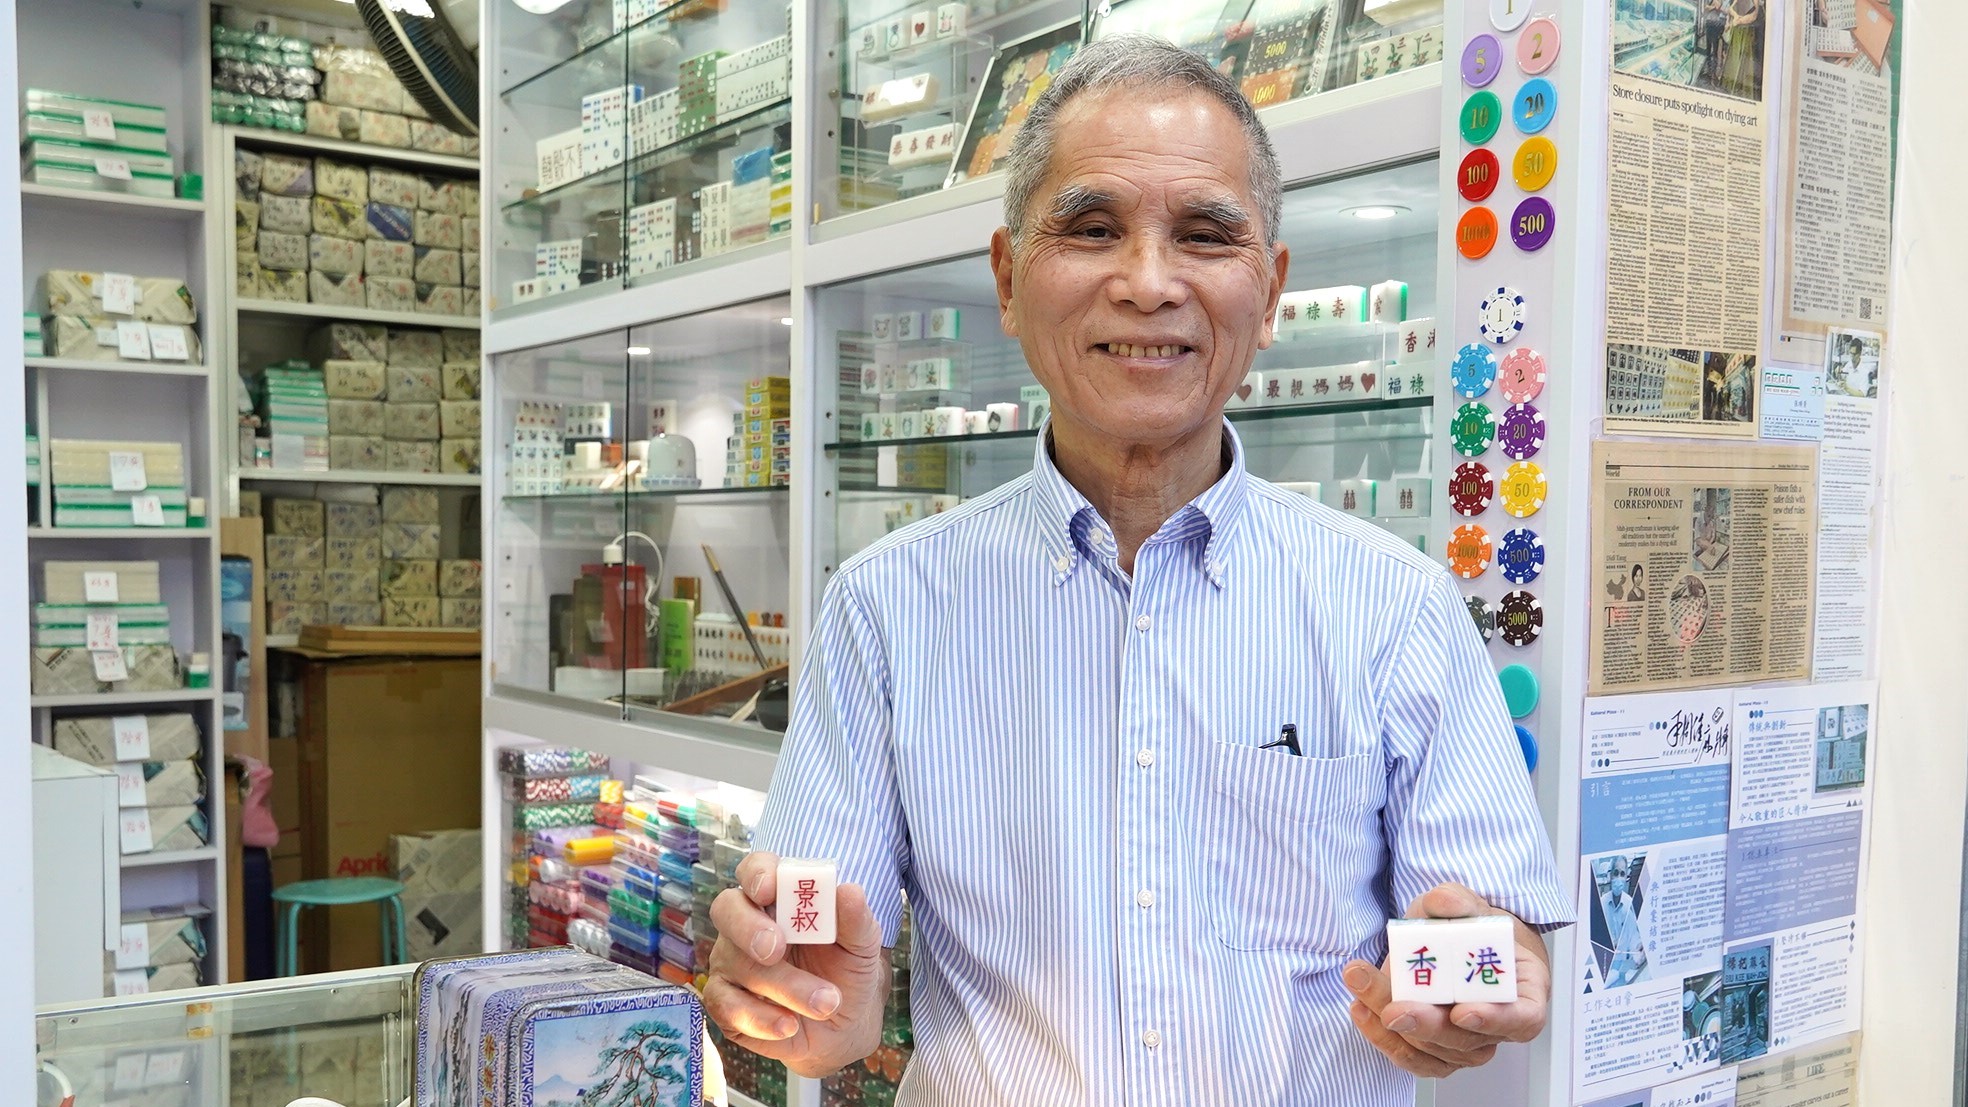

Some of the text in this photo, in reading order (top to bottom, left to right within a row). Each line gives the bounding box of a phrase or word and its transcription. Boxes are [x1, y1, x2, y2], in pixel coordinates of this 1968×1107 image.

[1264, 41, 1287, 58] 5000
[1531, 32, 1543, 59] 2
[1475, 48, 1486, 74] 5
[1253, 83, 1276, 104] 1000
[1524, 92, 1545, 119] 20
[1612, 84, 1634, 100] Store
[1634, 88, 1662, 106] closure
[1663, 96, 1681, 110] puts
[1681, 98, 1714, 117] spotlight
[1714, 109, 1724, 119] on
[1725, 109, 1746, 127] dying
[1747, 115, 1758, 127] art
[1470, 105, 1489, 129] 10
[1523, 151, 1544, 177] 50
[1466, 163, 1489, 186] 100
[1461, 224, 1490, 242] 1000
[1518, 213, 1545, 236] 500
[1281, 296, 1345, 322] 福祿壽
[1498, 308, 1503, 322] 1
[1467, 363, 1476, 378] 5
[1515, 368, 1525, 383] 2
[1266, 375, 1354, 399] 最靚媽媽
[1387, 373, 1425, 396] 福祿
[1463, 422, 1478, 436] 10
[1513, 423, 1527, 440] 20
[1461, 481, 1477, 496] 100
[1514, 483, 1529, 497] 50
[1628, 487, 1671, 497] FROM OUR
[1773, 484, 1789, 493] Poison
[1789, 484, 1798, 493] fish
[1613, 499, 1683, 509] CORRESPONDENT
[1784, 495, 1795, 504] dish
[1795, 495, 1806, 504] with
[1783, 506, 1793, 514] chef
[1456, 544, 1479, 560] 1000
[1509, 547, 1530, 564] 500
[1507, 612, 1528, 627] 5000
[790, 878, 820, 933] 景叔
[1406, 945, 1506, 987] 香港
[1583, 991, 1633, 1014] 工作之日常
